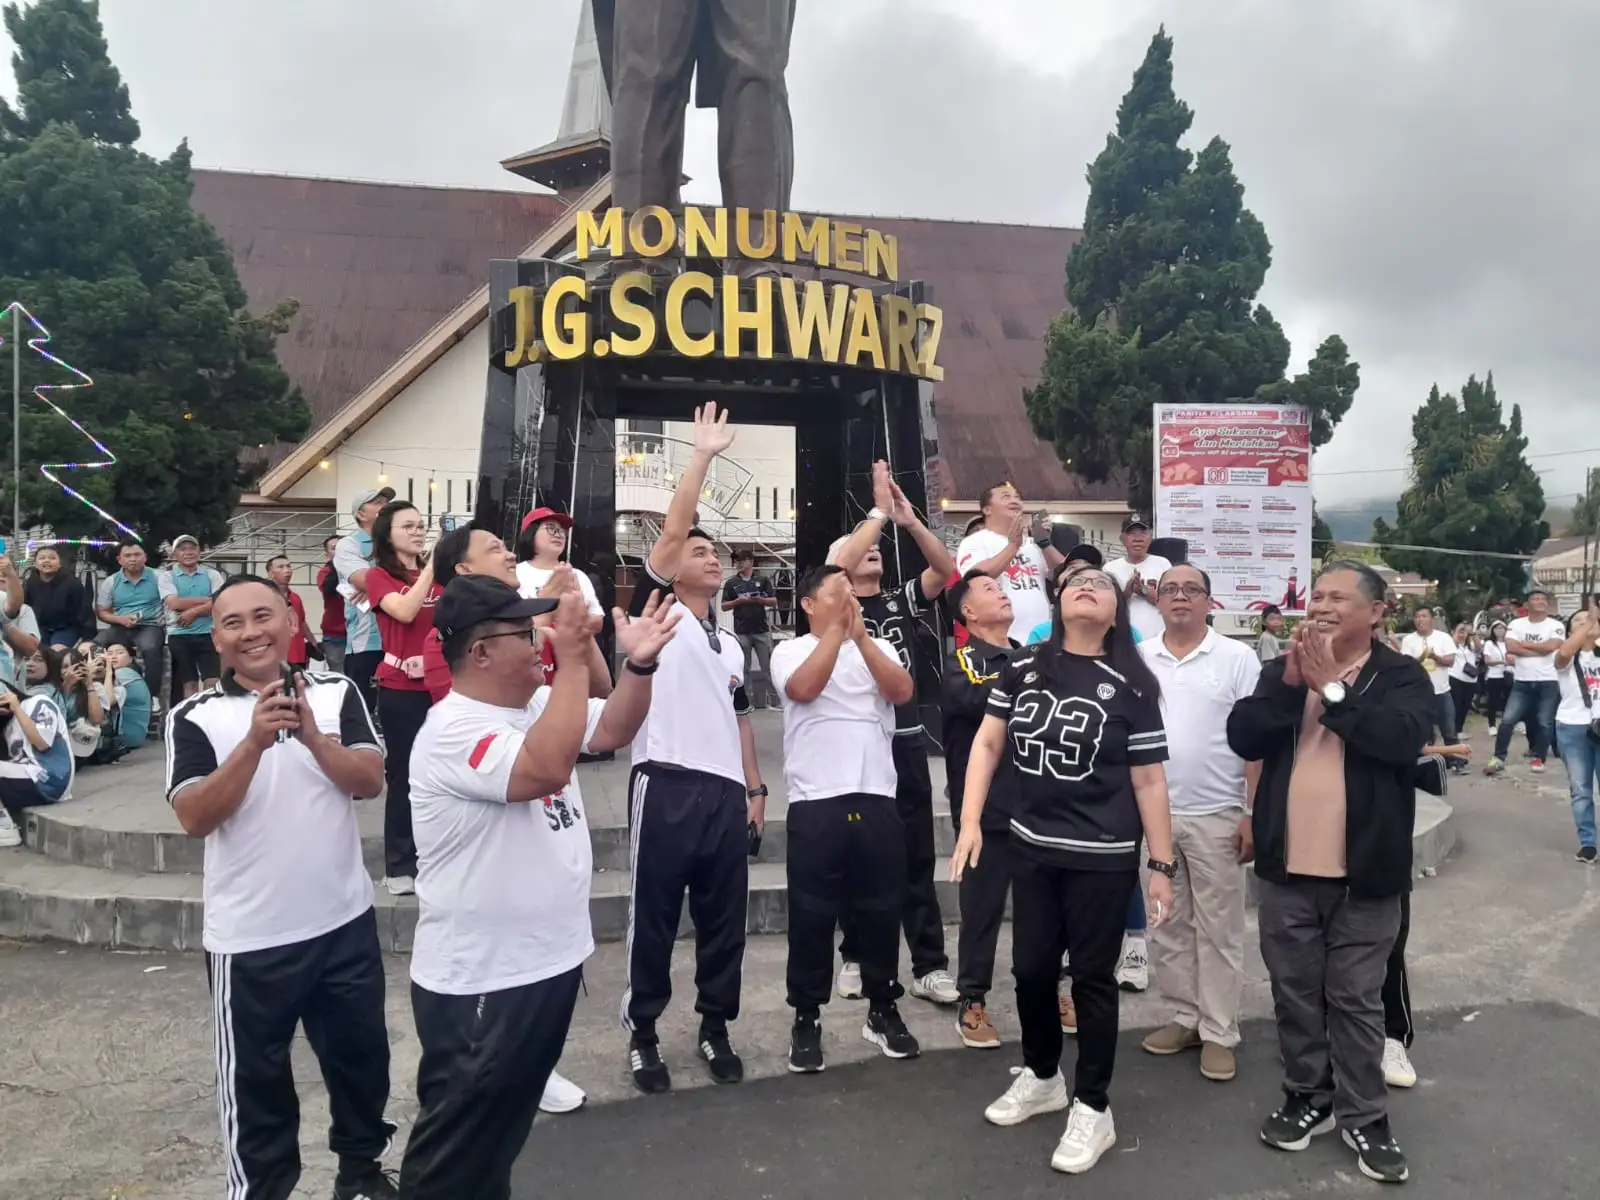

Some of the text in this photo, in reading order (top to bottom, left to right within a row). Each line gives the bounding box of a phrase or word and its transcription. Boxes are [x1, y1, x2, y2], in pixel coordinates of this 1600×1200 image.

[576, 206, 898, 282] MONUMEN
[505, 272, 944, 382] J.G.SCHWARZ
[1191, 427, 1215, 439] Ayo
[1194, 438, 1217, 449] dan
[1208, 467, 1228, 484] 80
[1008, 689, 1107, 781] 23
